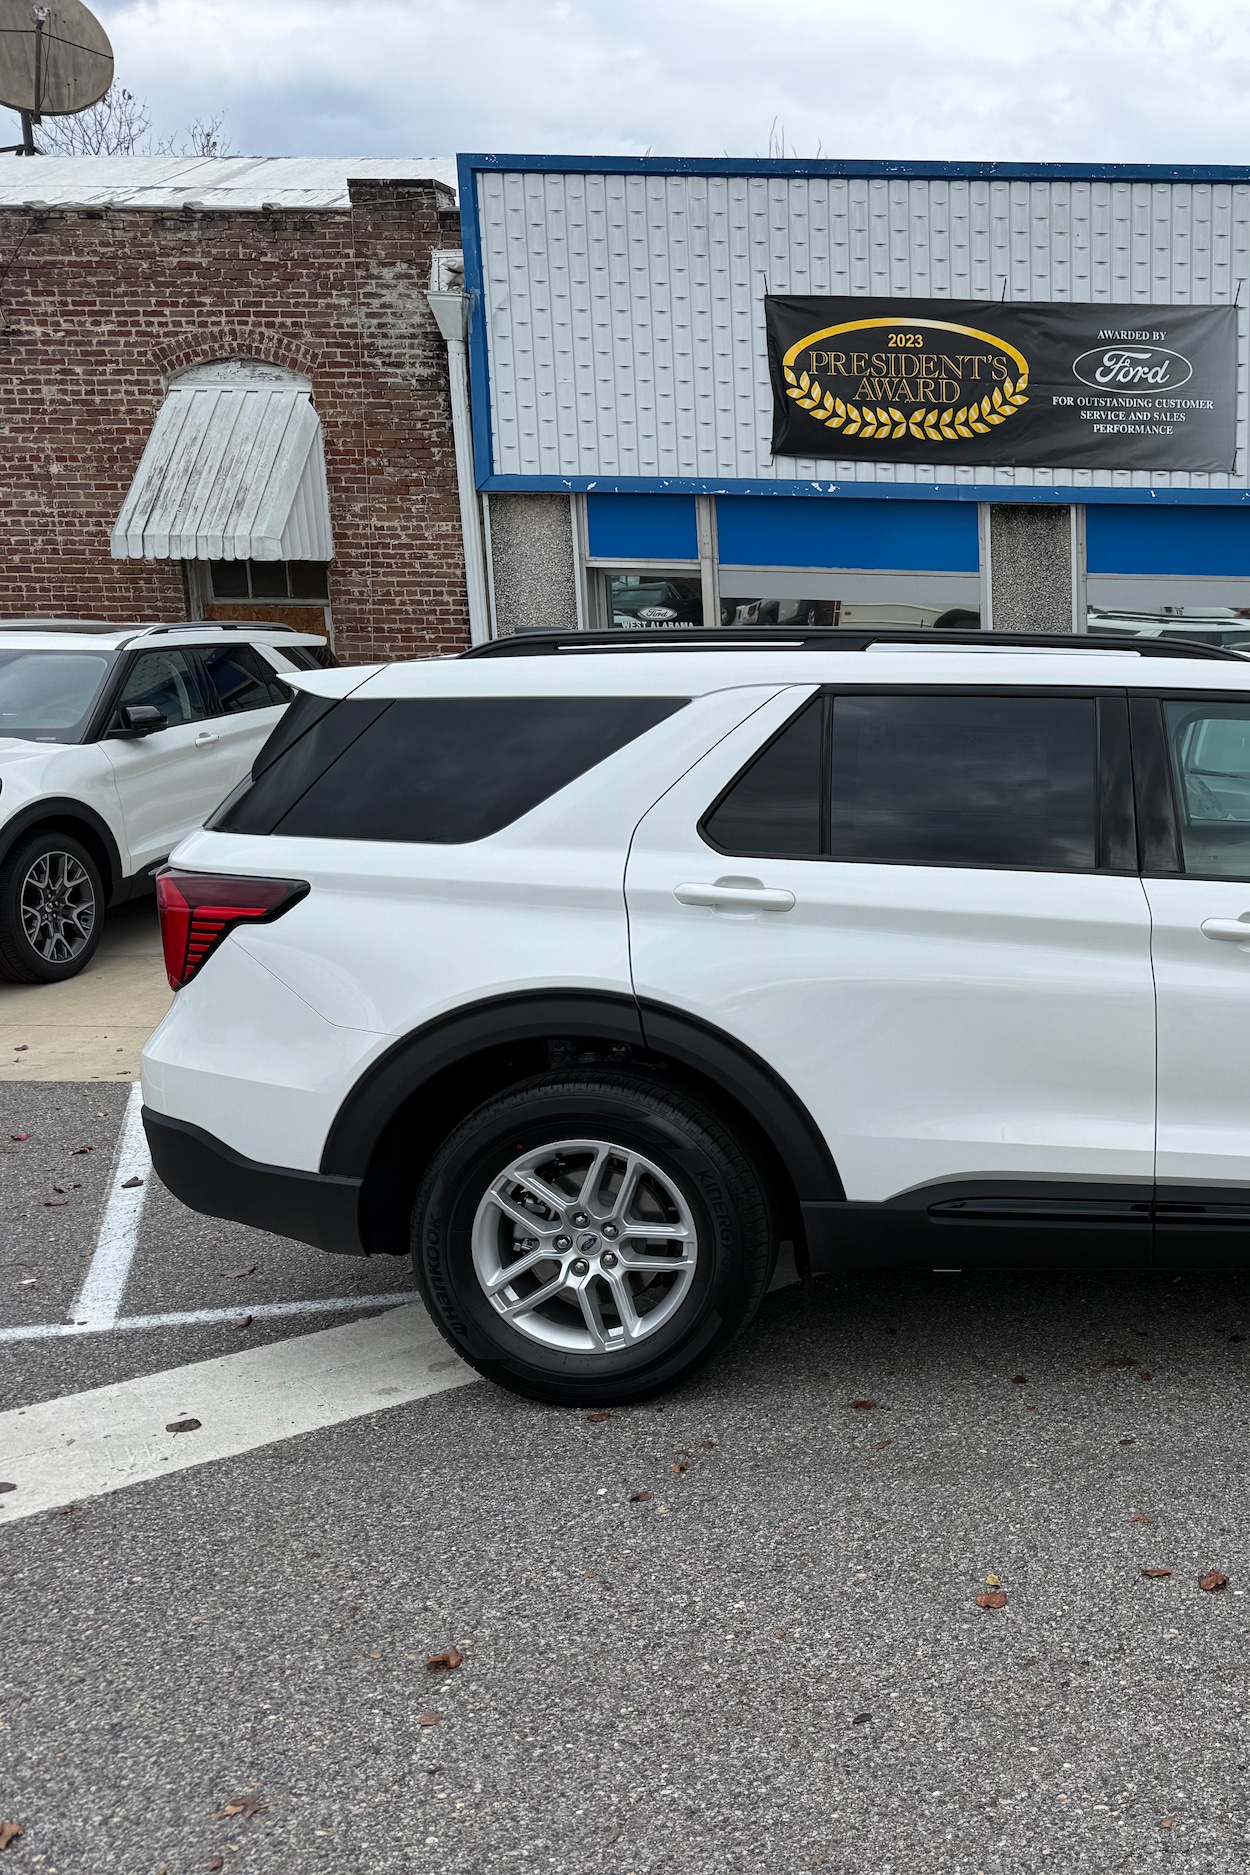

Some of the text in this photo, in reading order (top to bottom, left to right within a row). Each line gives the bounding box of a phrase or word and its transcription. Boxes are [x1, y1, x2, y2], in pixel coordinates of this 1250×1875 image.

[888, 334, 924, 348] 2023
[1097, 330, 1167, 341] AWARDED BY
[808, 351, 1008, 381] PRESIDENT'S
[1095, 350, 1170, 384] Ford
[852, 377, 961, 404] AWARD
[1052, 396, 1214, 410] FOR OUTSTANDING CUSTOMER
[1080, 410, 1186, 422] SERVICE AND SALES
[1093, 423, 1174, 435] PERFORMANCE
[646, 609, 668, 617] Ford
[621, 621, 647, 629] WEST
